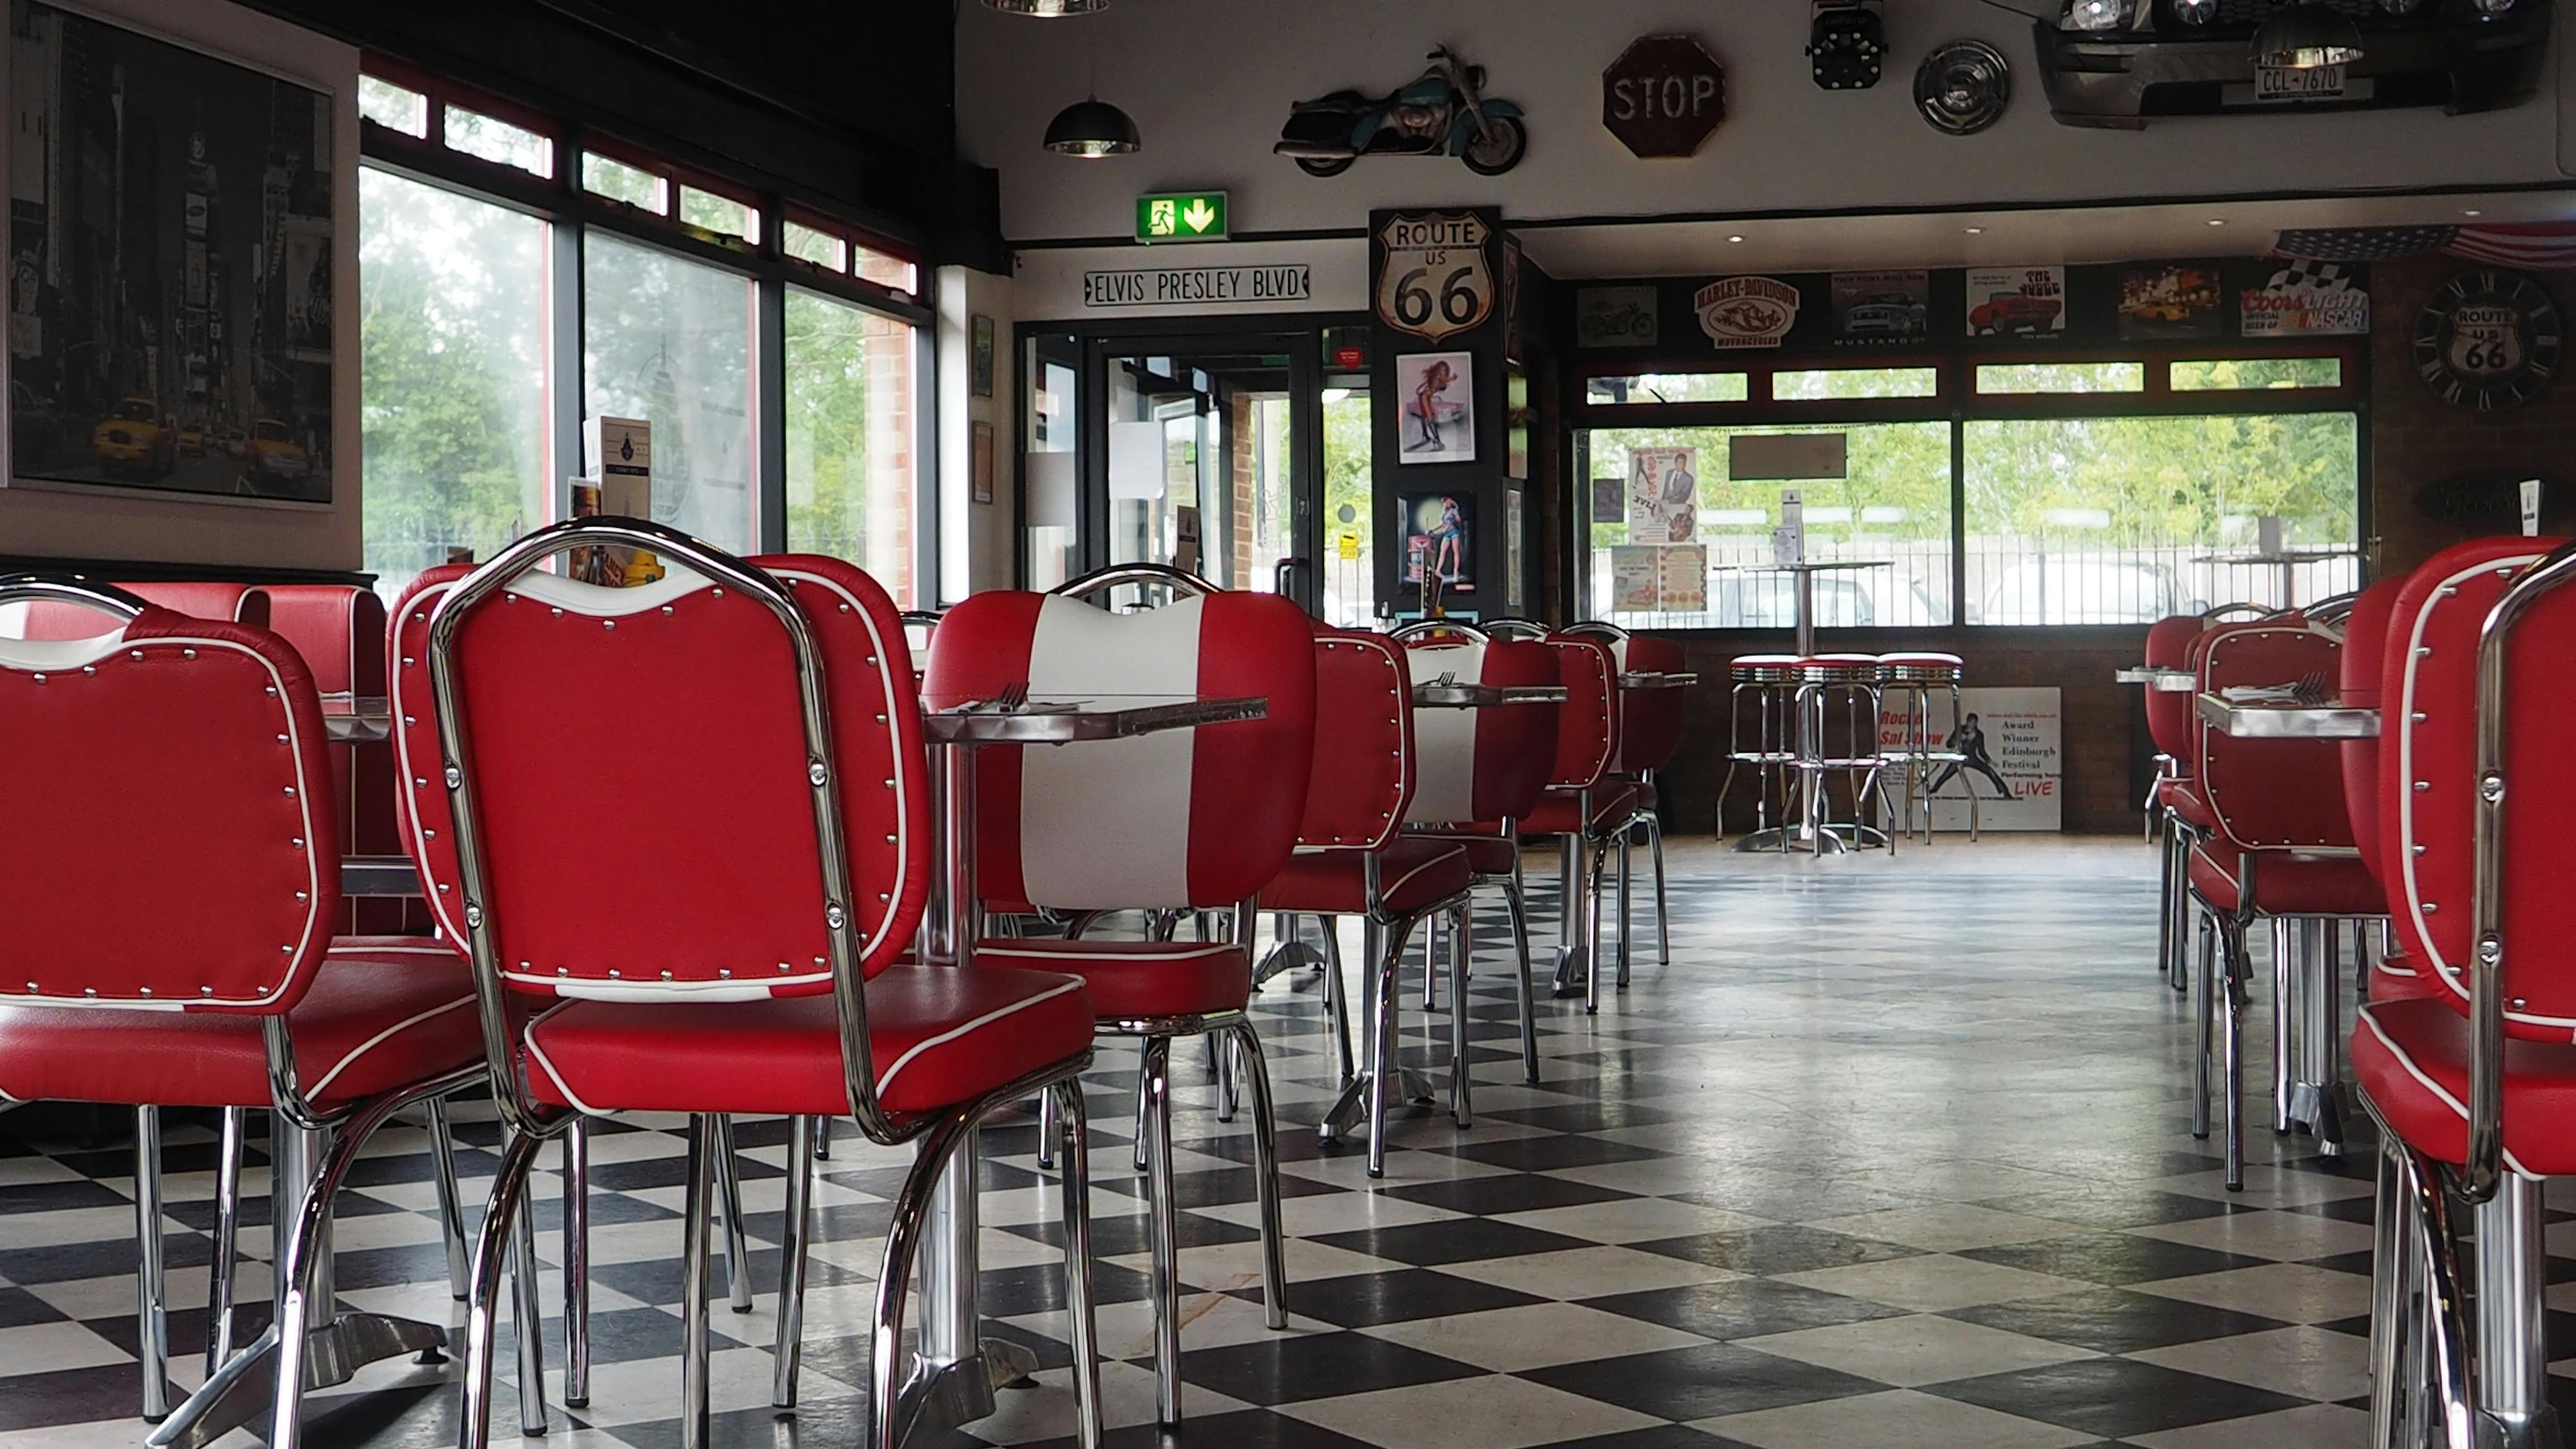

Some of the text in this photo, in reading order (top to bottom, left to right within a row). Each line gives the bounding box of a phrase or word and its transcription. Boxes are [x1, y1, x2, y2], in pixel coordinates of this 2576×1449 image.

[2264, 68, 2336, 92] CCL 7670
[1613, 74, 1716, 121] STOP
[1397, 222, 1475, 245] ROUTE
[1425, 250, 1446, 266] US
[2025, 270, 2051, 282] THE
[1095, 269, 1298, 302] ELVIS PRESLEY BLVD
[1698, 278, 1797, 309] HARLEY-DAVIDSON
[2019, 282, 2061, 297] JUDGE
[1395, 266, 1479, 326] 66
[2242, 287, 2365, 312] Coors LIGHT
[2305, 310, 2367, 328] NASCAR
[2459, 311, 2513, 323] ROUTE
[2465, 339, 2507, 369] 66
[2002, 721, 2034, 729] Award
[2002, 733, 2039, 742] Winner
[2002, 747, 2056, 757] Edinburgh
[2002, 760, 2040, 768] Festival
[2015, 781, 2053, 796] LIVE
